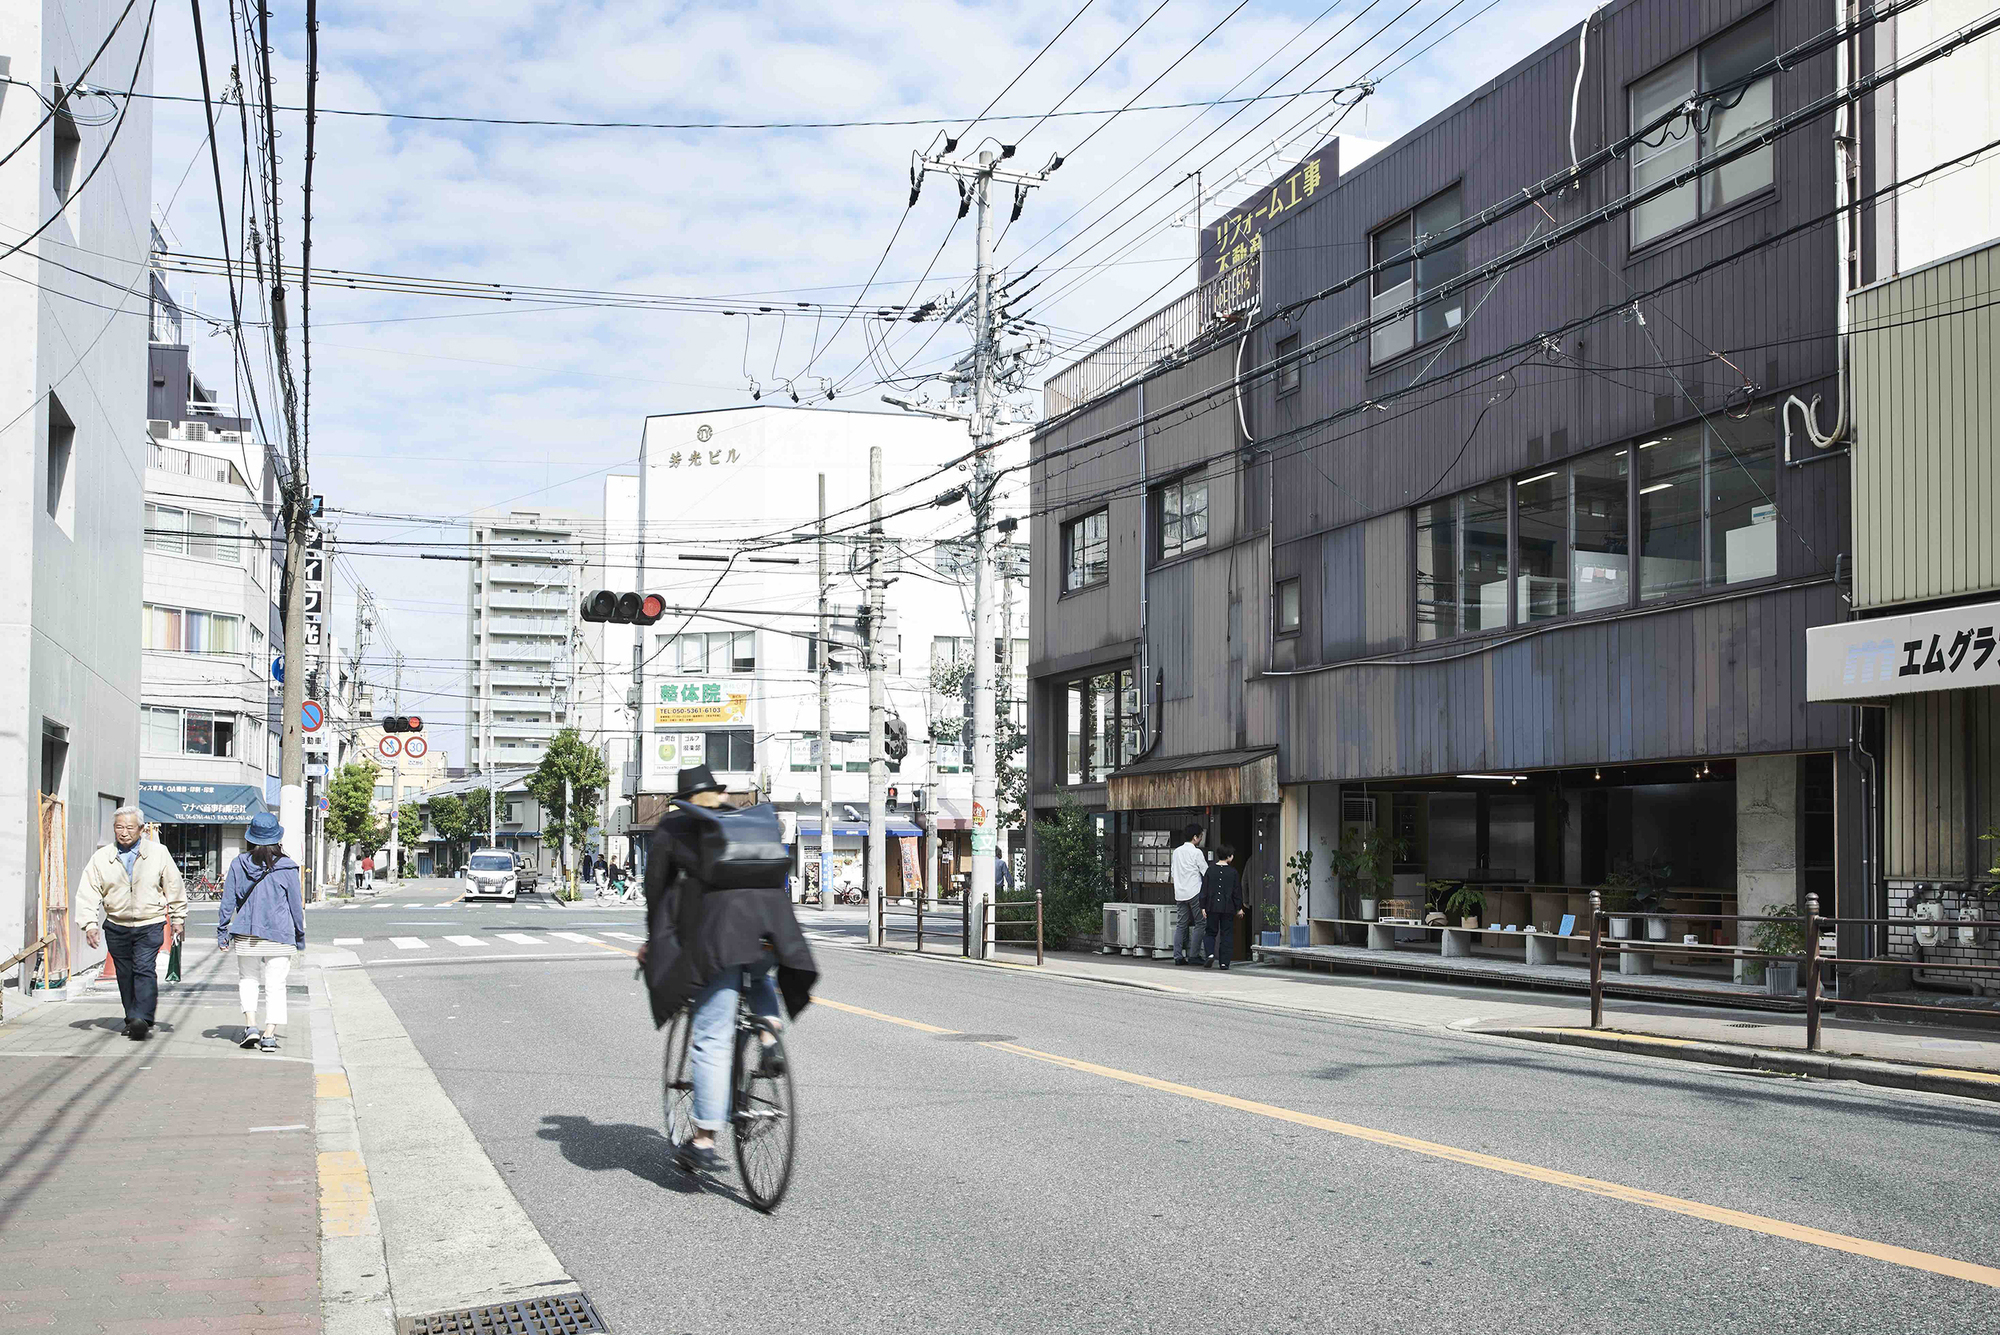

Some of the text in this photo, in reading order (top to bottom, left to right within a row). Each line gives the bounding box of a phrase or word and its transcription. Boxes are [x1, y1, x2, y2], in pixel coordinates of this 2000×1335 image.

[1216, 158, 1321, 253] リフォーム工事
[669, 448, 741, 468] 芳光ビル
[1898, 626, 2000, 677] エムグラ
[660, 683, 721, 703] 整体院
[410, 742, 422, 752] 30
